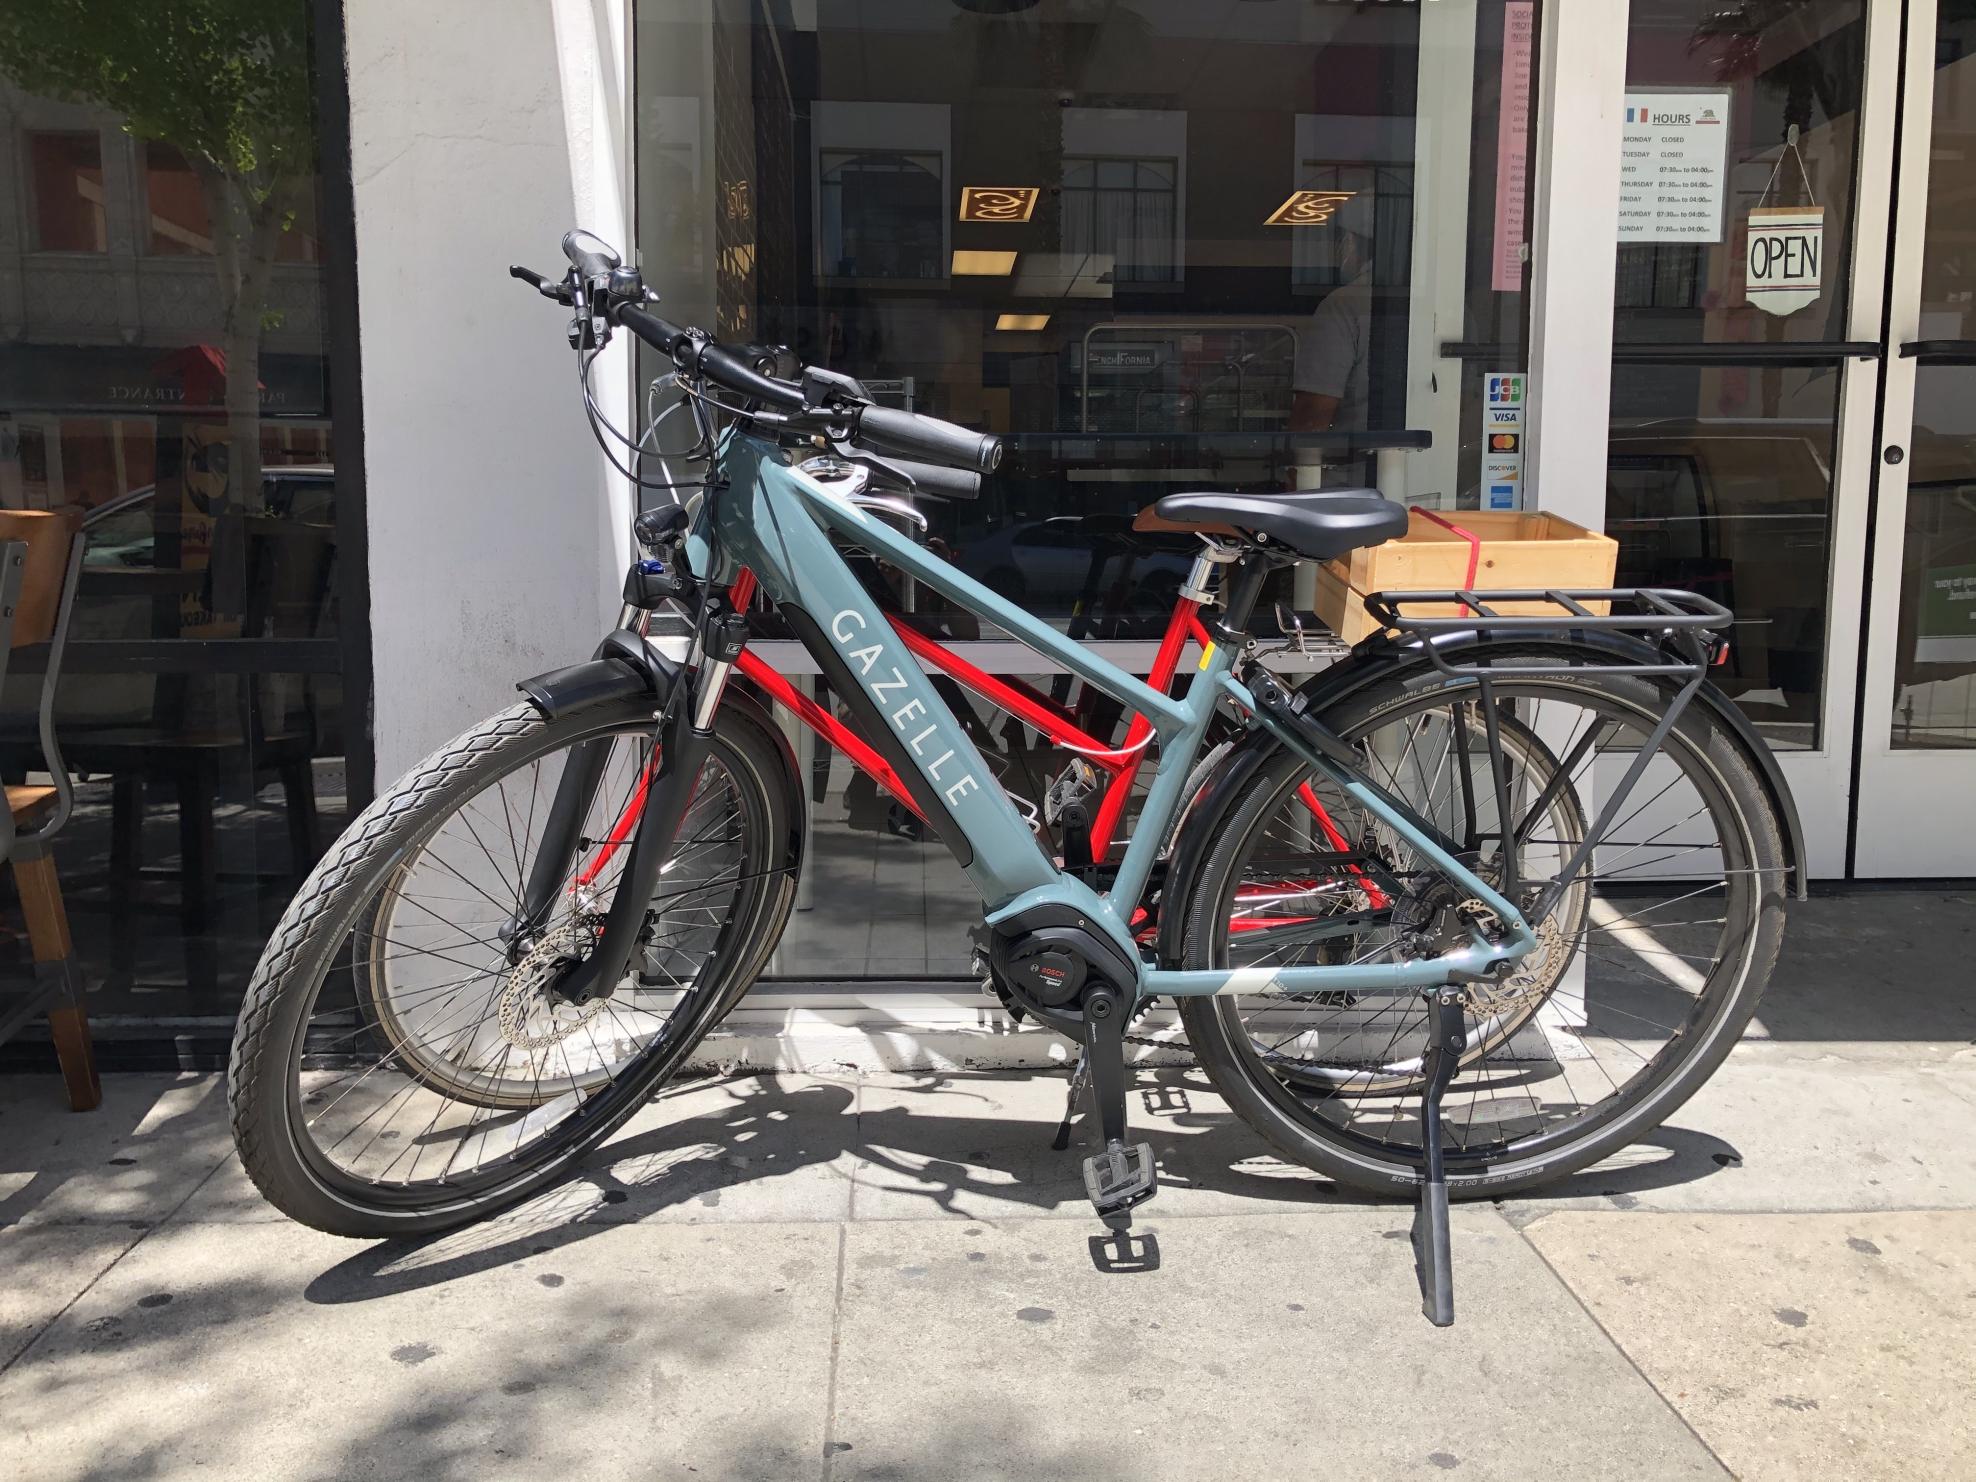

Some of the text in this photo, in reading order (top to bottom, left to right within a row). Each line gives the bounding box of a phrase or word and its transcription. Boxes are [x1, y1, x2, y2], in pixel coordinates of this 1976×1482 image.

[1652, 113, 1691, 125] HOURS
[1750, 235, 1819, 279] OPEN
[1494, 413, 1517, 422] VISA
[832, 609, 979, 807] GAZELLE
[1368, 682, 1440, 714] SCHWALBE
[1041, 967, 1066, 978] BOSCH
